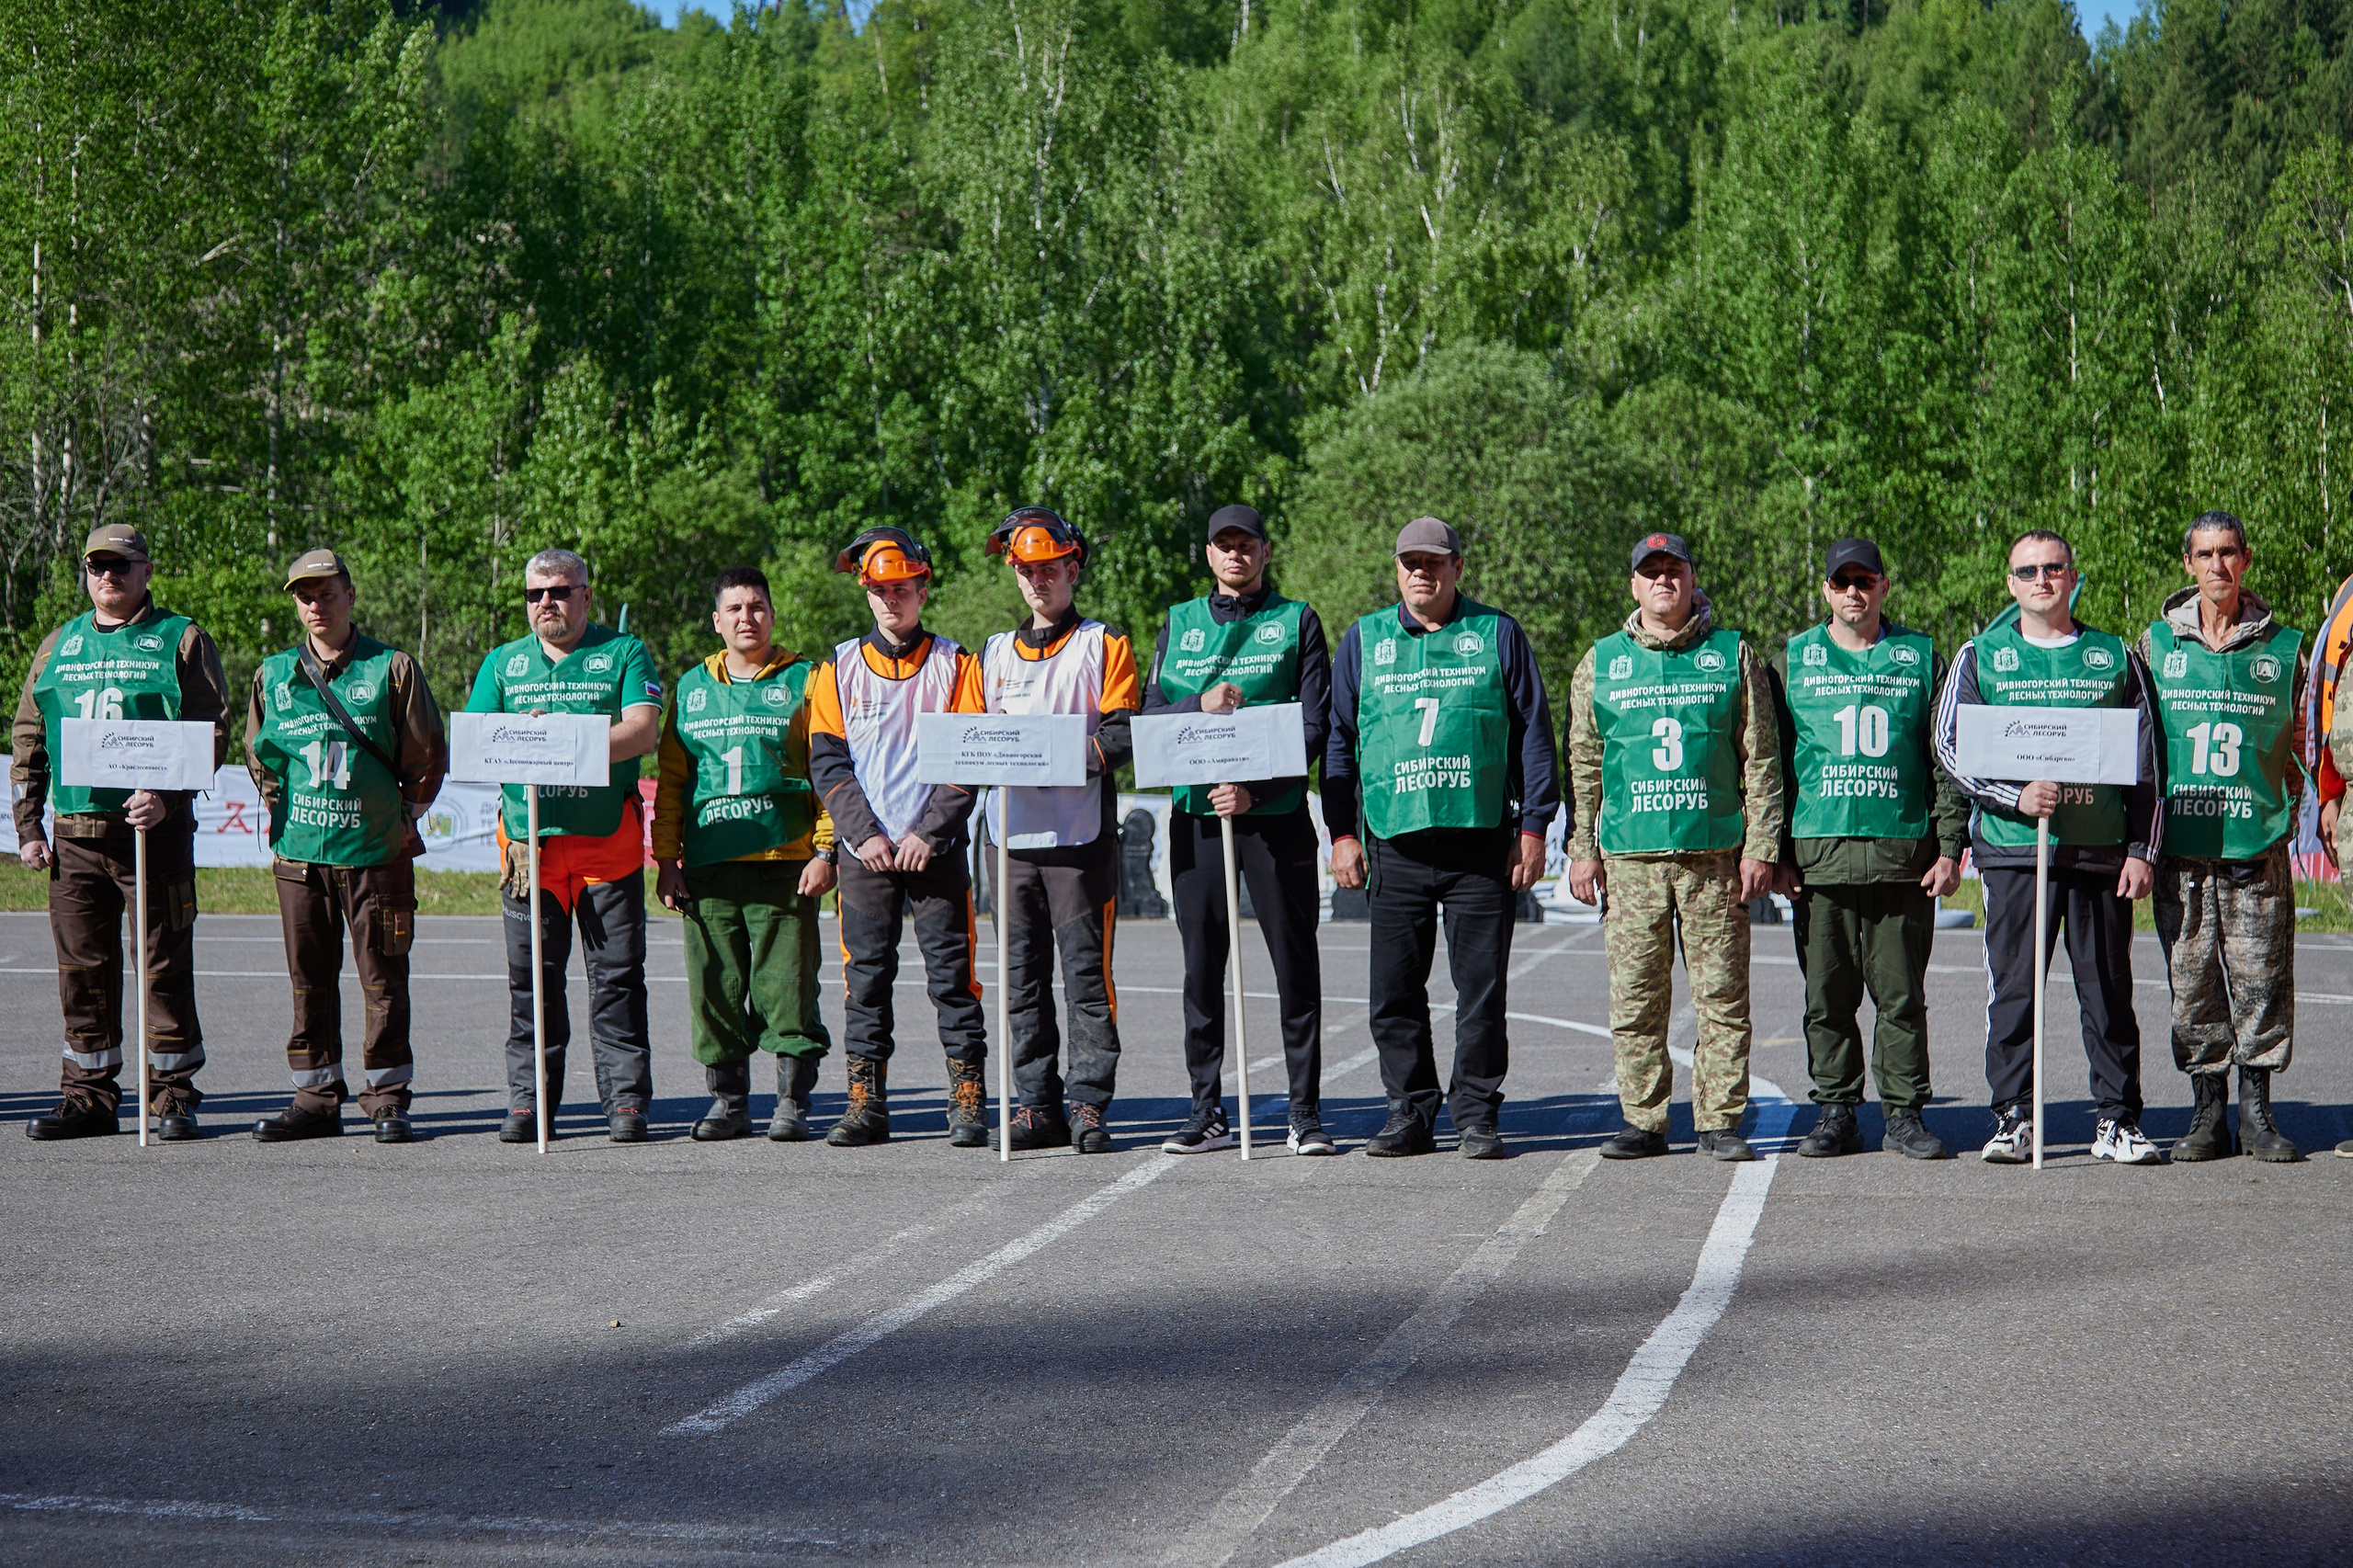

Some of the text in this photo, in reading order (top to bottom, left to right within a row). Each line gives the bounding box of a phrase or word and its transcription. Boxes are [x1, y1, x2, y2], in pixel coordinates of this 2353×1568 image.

[55, 659, 159, 674] ДИВНОГОРСКИЙ ТЕХНИКУМ
[1176, 653, 1285, 669] ДИВНОГОРСКИЙ ТЕХНИКУМ
[1184, 663, 1274, 677] ЛЕСНЫХ ТЕХНОЛОГИЙ
[62, 669, 146, 682] ЛЕСНЫХ ТЕХНОЛОГИЙ
[1374, 665, 1486, 687] ДИВНОГОРСКИЙ ТЕХНИКУМ
[1803, 673, 1920, 688] ДИВНОГОРСКИЙ ТЕХНИКУМ
[505, 680, 611, 697] ДИВНОГОРСКИЙ ТЕХНИКУМ
[1383, 676, 1475, 695] ЛЕСНЫХ ТЕХНОЛОГИЙ
[1608, 683, 1727, 702] ДИВНОГОРСКИЙ ТЕХНИКУМ
[1814, 685, 1908, 698] ЛЕСНЫХ ТЕХНОЛОГИЙ
[1995, 677, 2115, 693] ДИВНОГОРСКИЙ ТЕХНИКУМ
[74, 687, 123, 721] 16
[514, 691, 600, 705] ЛЕСНЫХ ТЕХНОЛОГИЙ
[1620, 693, 1715, 710] ЛЕСНЫХ ТЕХНОЛОГИЙ
[2008, 689, 2105, 702] ЛЕСНЫХ ТЕХНОЛОГИЙ
[2161, 688, 2277, 706] ДИВНОГОРСКИЙ ТЕХНИКУМ
[2171, 700, 2265, 716] ЛЕСНЫХ ТЕХНОЛОГИЙ
[278, 712, 331, 732] ДИВНОГОРСК
[684, 713, 790, 733] ДИВНОГОРСКИЙ ТЕХНИКУМ
[1195, 726, 1236, 734] СИБИРСКИЙ
[1415, 697, 1439, 747] 7
[1833, 704, 1889, 758] 10
[692, 724, 779, 741] ЛЕСНЫХ ТЕХНОЛОГИЙ
[1203, 733, 1236, 741] ЛЕСОРУБ
[1652, 717, 1684, 772] 3
[2186, 722, 2243, 778] 13
[299, 740, 351, 790] 14
[721, 745, 743, 796] 1
[1393, 755, 1471, 777] СИБИРСКИЙ
[1822, 765, 1898, 781] СИБИРСКИЙ
[1394, 770, 1472, 795] ЛЕСОРУБ
[1631, 777, 1708, 794] СИБИРСКИЙ
[1820, 778, 1899, 800] ЛЕСОРУБ
[522, 784, 589, 801] ЛСОРУБ
[2173, 783, 2253, 801] СИБИРСКИЙ
[292, 792, 362, 812] СИБИРСКИЙ
[705, 794, 774, 826] ЛЕСОРУБ
[1631, 792, 1709, 813] ЛЕСОРУБ
[2172, 798, 2253, 819] ЛЕСОРУБ
[290, 806, 361, 829] ЛЕСОРУБ
